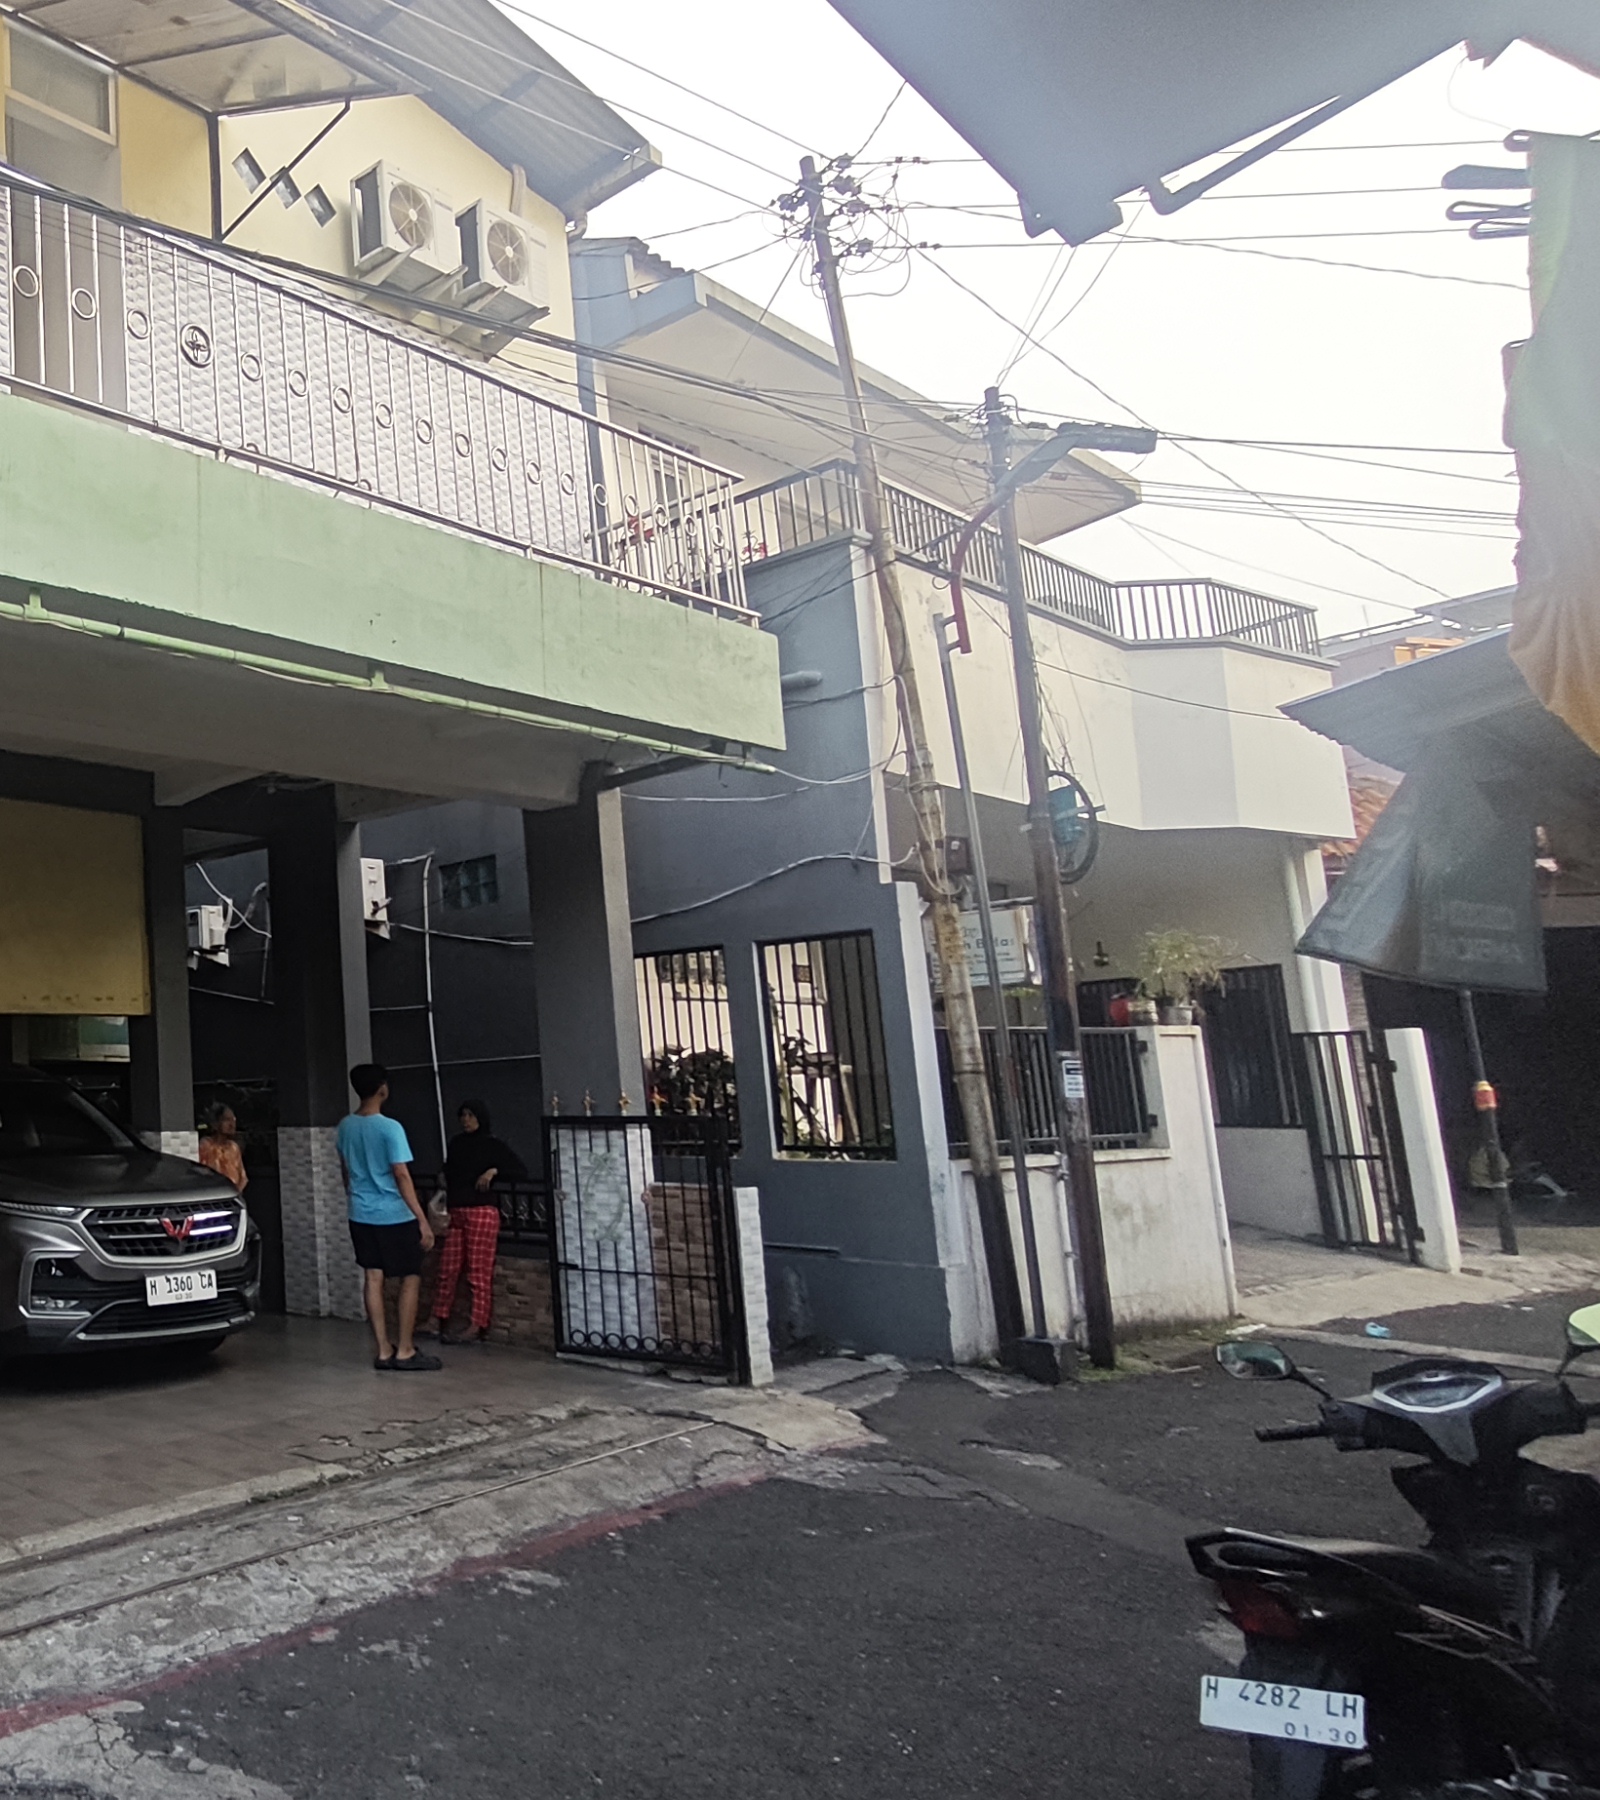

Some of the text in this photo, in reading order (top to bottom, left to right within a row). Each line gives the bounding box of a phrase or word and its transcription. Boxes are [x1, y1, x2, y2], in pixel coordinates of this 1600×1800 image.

[150, 1273, 213, 1296] H 1360 CA
[1205, 1677, 1358, 1719] H 4282 LH
